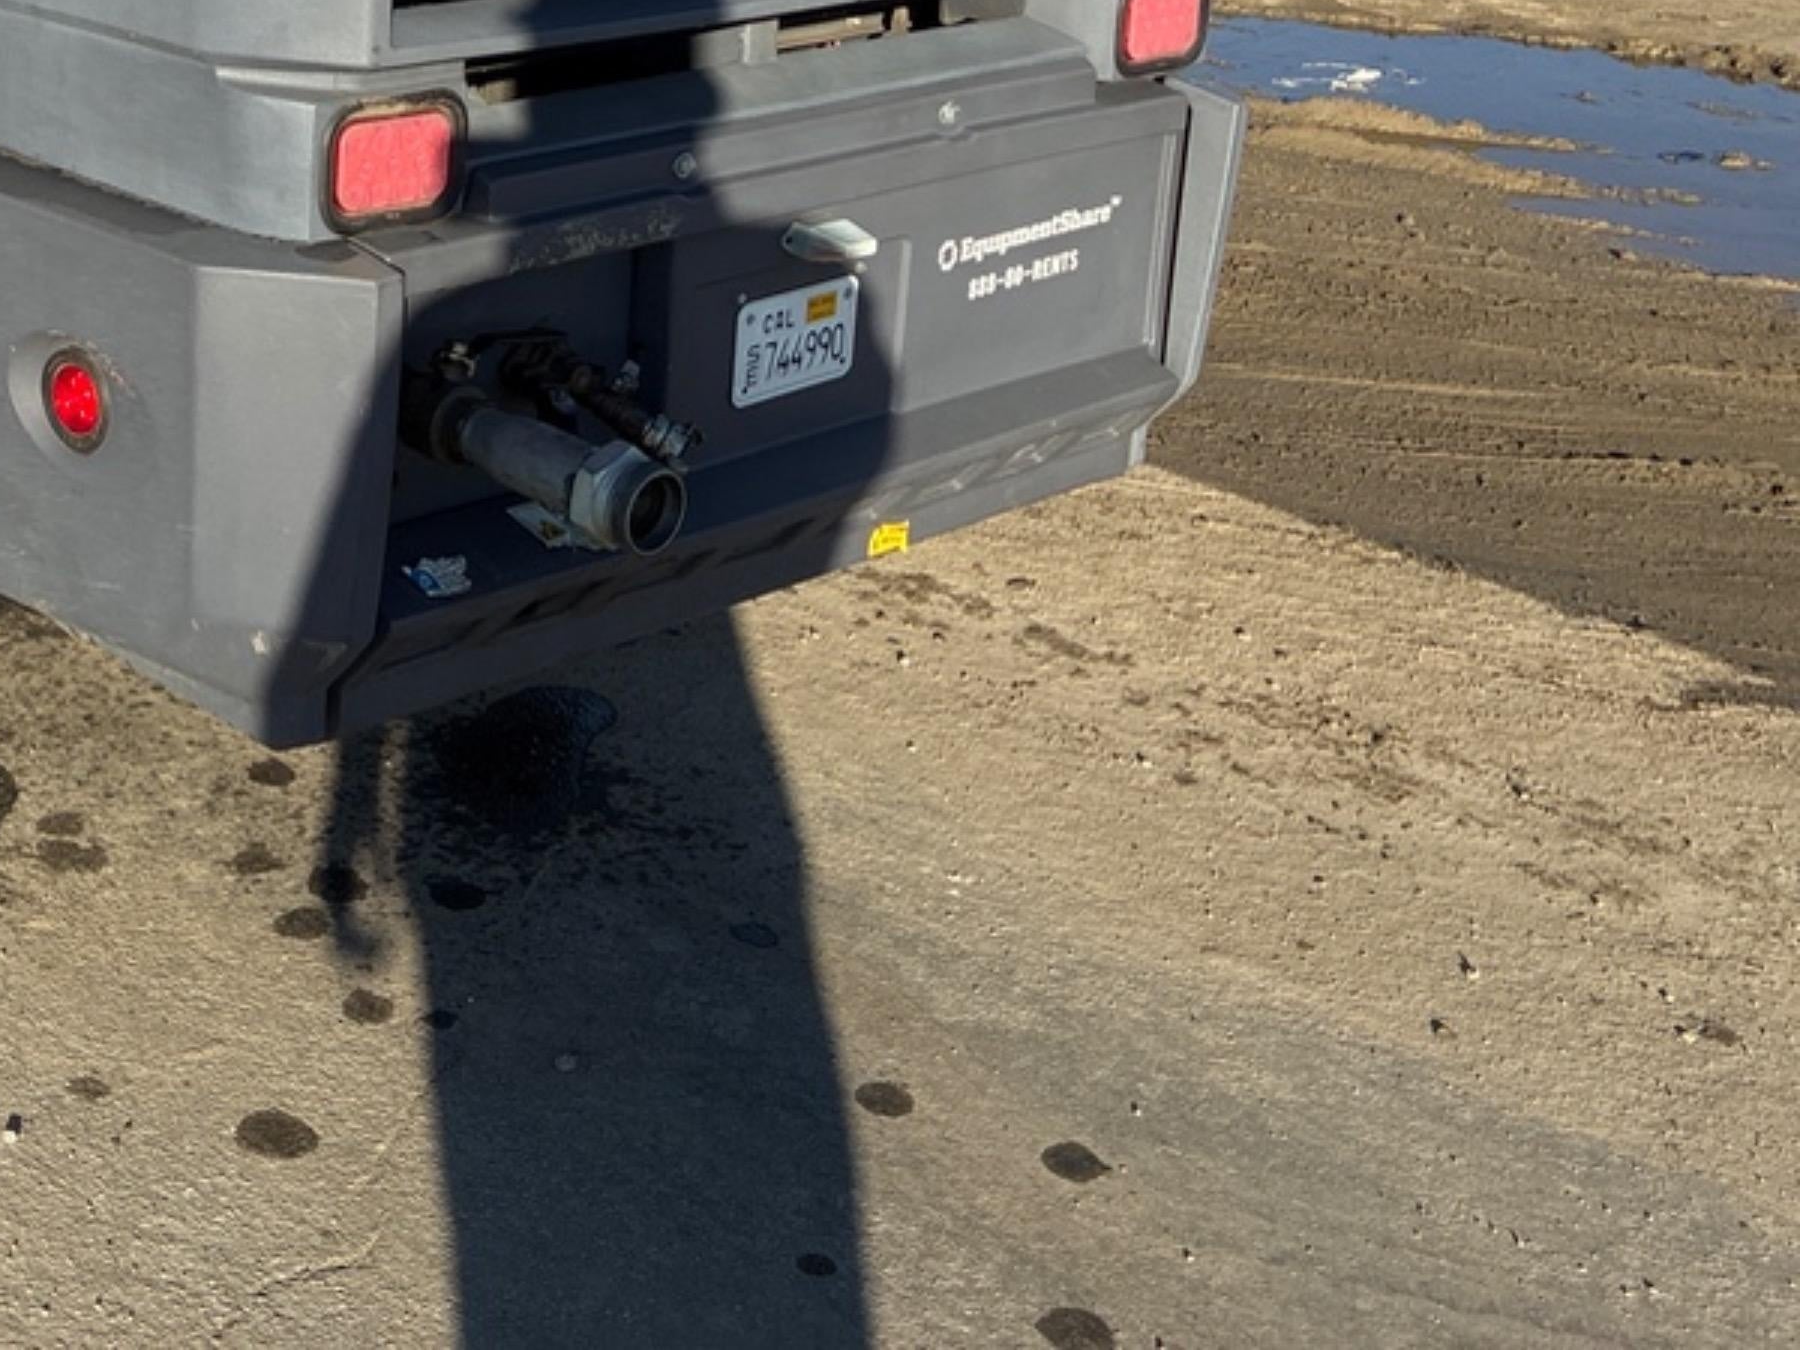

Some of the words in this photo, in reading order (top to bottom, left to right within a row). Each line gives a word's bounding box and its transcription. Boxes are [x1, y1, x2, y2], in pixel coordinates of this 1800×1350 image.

[960, 204, 1112, 263] EquipmentShare
[968, 248, 1079, 301] 888-80-RENTS
[763, 310, 795, 334] CAL
[765, 322, 845, 380] 744990
